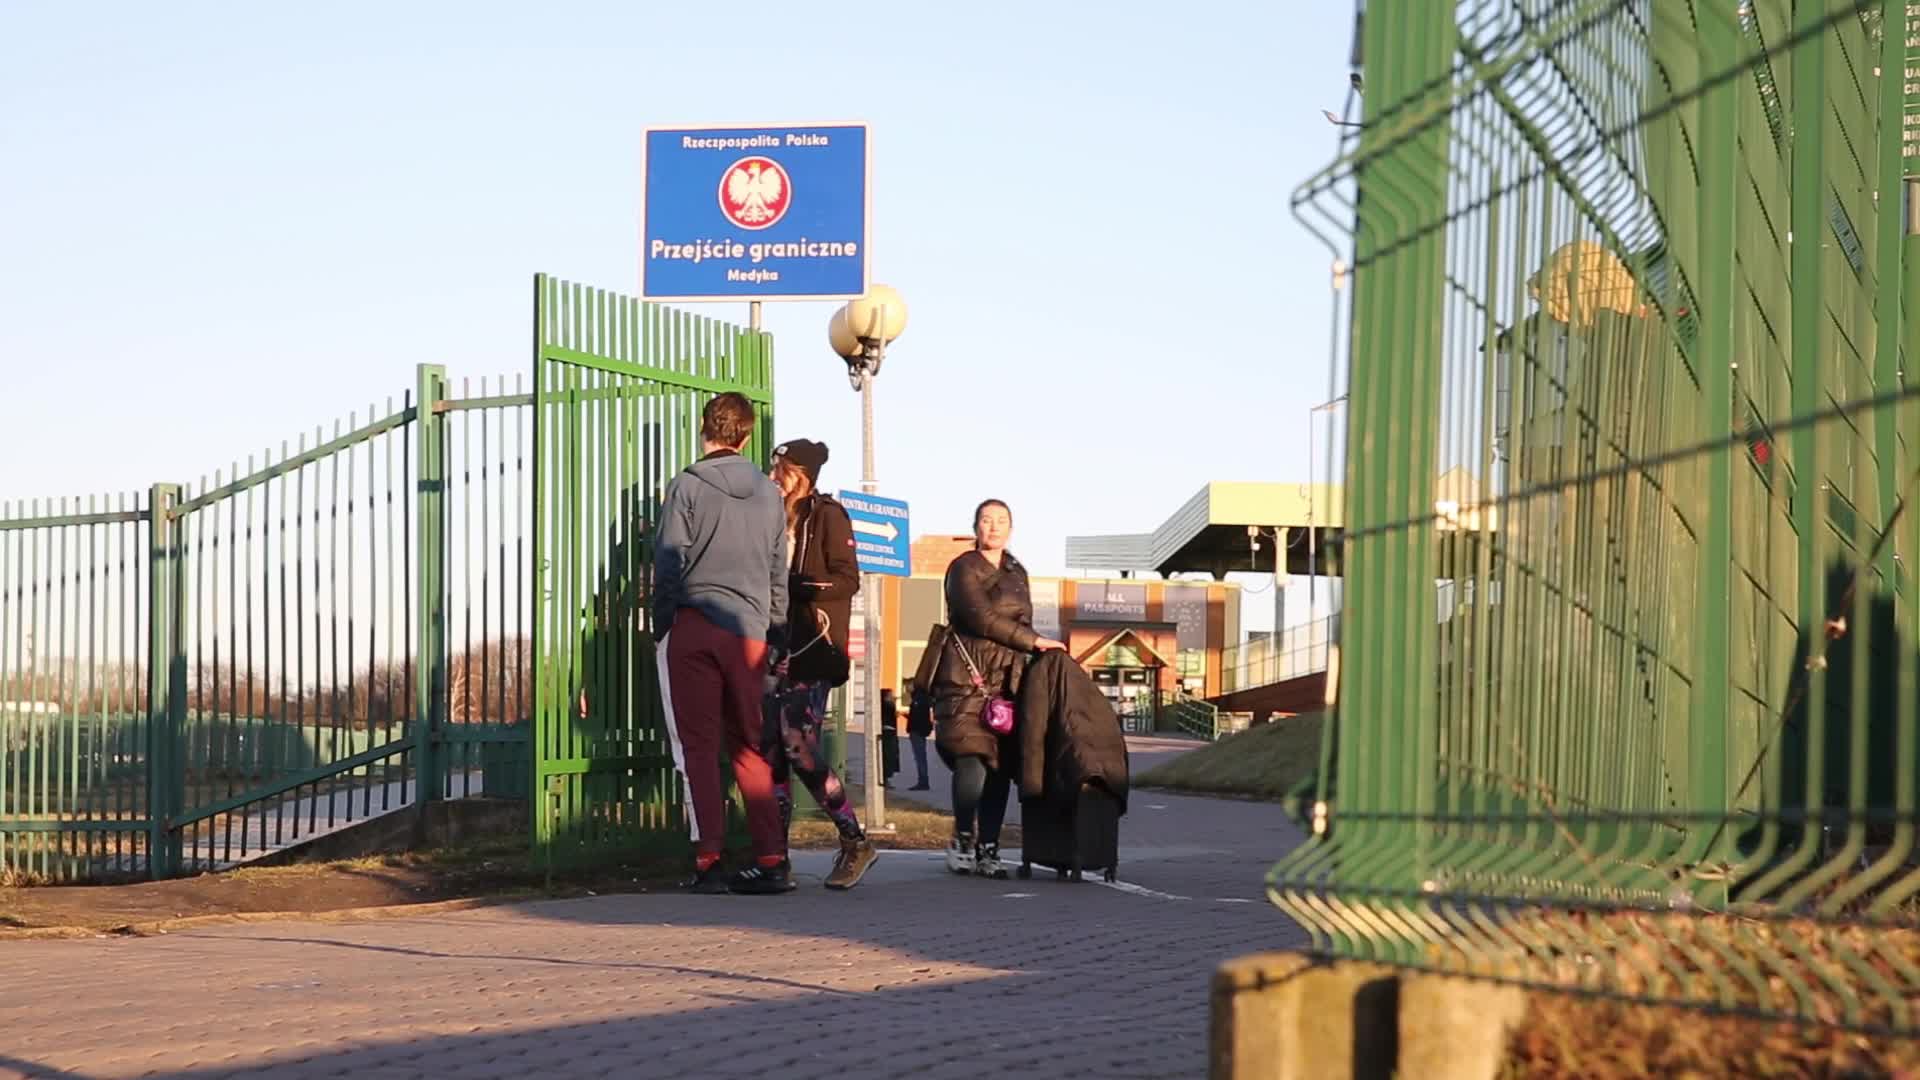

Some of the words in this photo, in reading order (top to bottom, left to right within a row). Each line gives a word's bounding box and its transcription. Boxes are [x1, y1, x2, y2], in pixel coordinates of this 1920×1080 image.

[682, 134, 780, 150] Rzeczpospolita
[786, 133, 829, 147] Polska
[651, 239, 745, 264] Przejście
[749, 237, 857, 262] graniczne
[727, 269, 779, 284] Medyka
[1084, 602, 1145, 614] PASSPORTS
